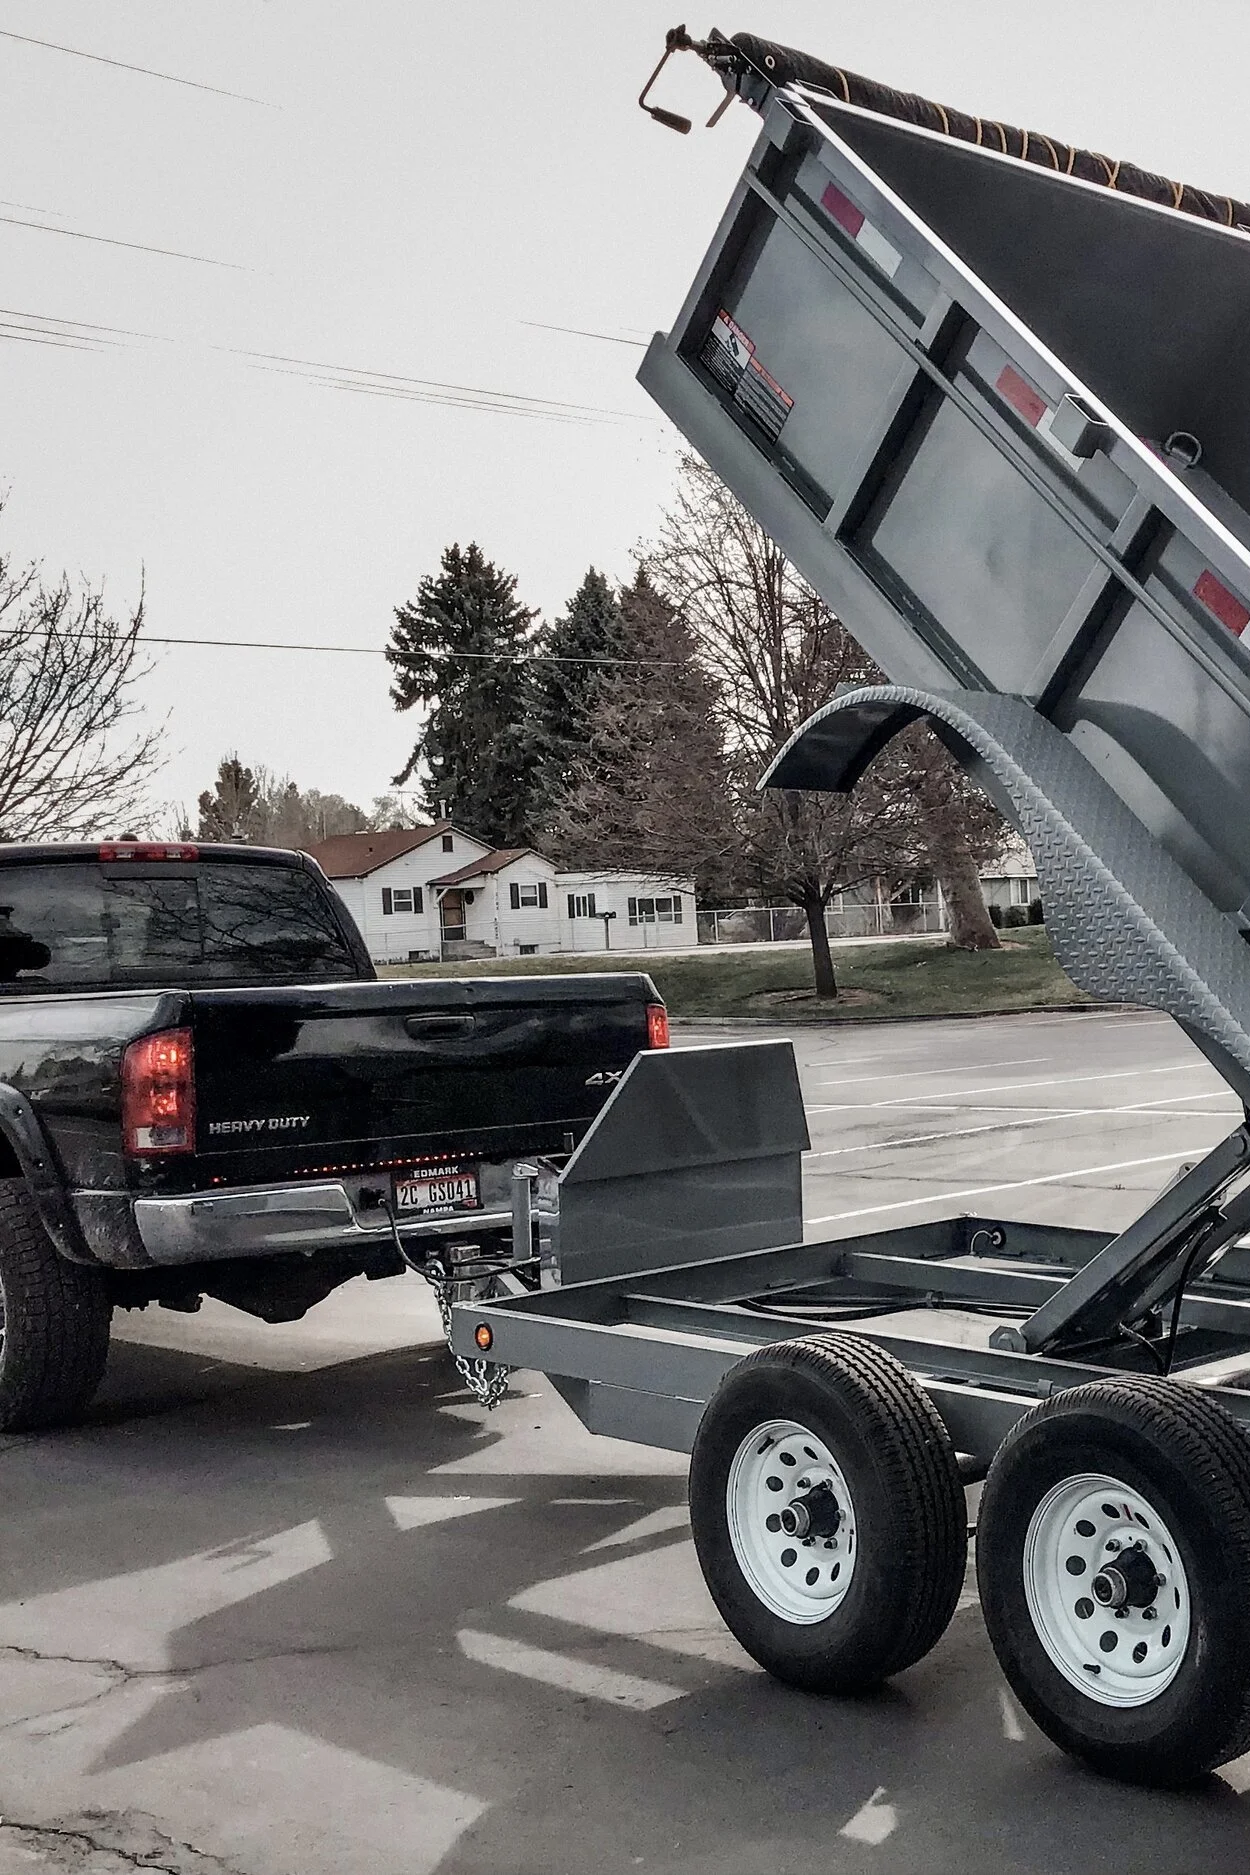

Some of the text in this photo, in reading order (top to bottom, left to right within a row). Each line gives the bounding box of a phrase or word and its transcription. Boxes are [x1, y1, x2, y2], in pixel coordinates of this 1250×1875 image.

[209, 1116, 310, 1134] HEAVY DUTY
[413, 1165, 458, 1178] EDMARK
[400, 1184, 418, 1206] 2C
[422, 1205, 454, 1214] NAMPA
